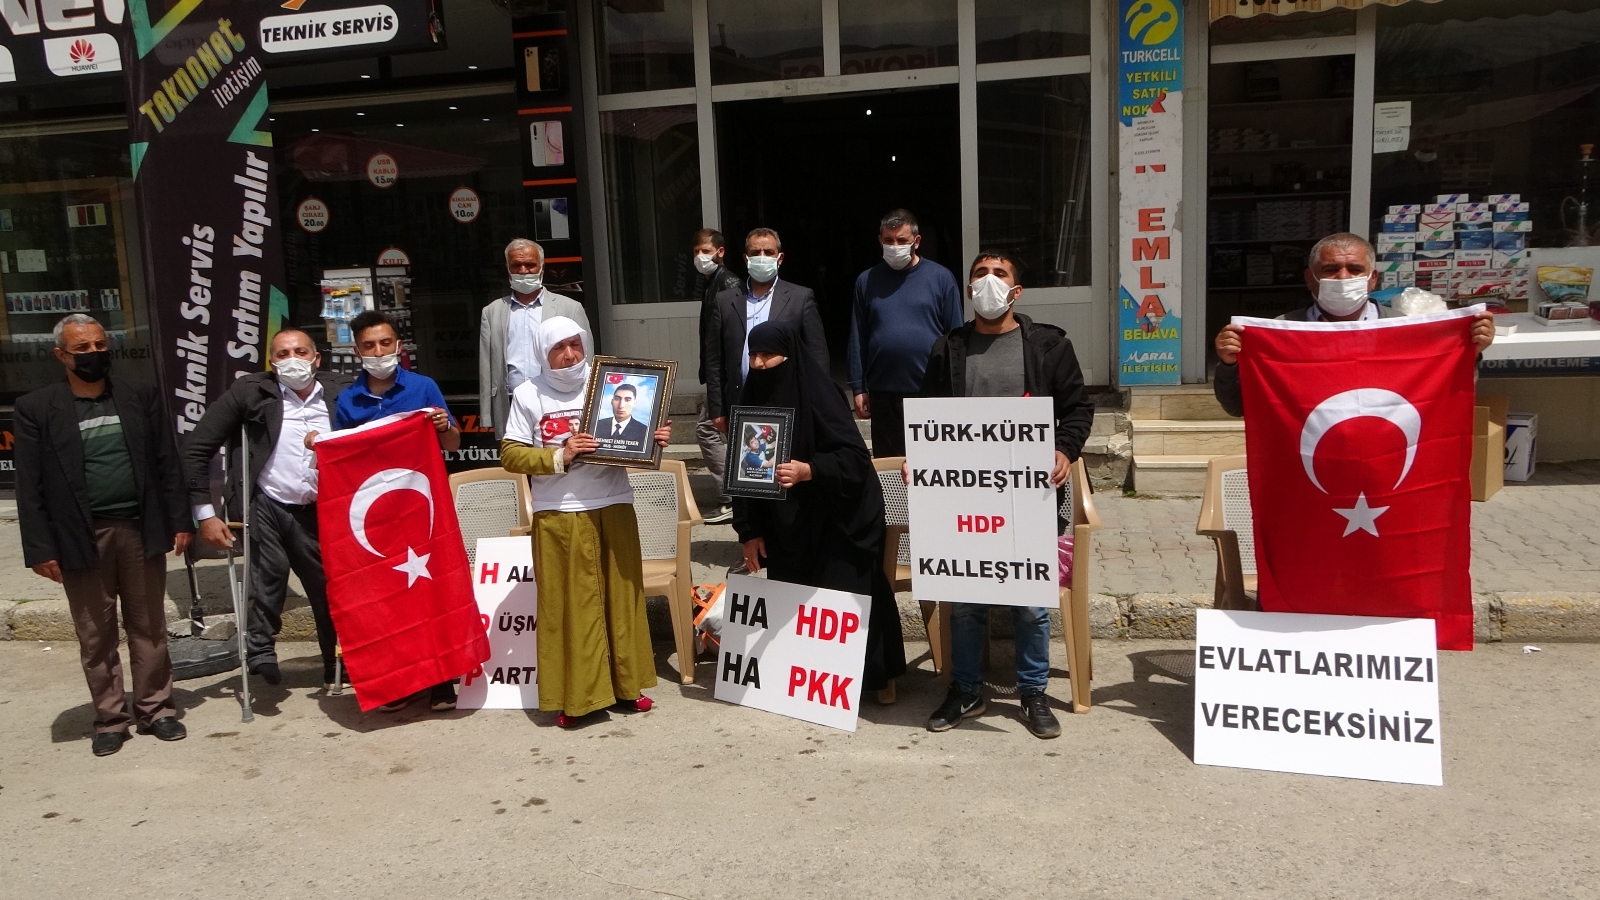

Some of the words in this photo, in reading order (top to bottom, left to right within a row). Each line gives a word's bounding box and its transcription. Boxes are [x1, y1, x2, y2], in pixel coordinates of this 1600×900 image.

[263, 20, 327, 43] TEKNİK
[332, 12, 393, 36] SERVİS
[71, 64, 98, 72] HUAWEI
[1122, 48, 1180, 63] TURKCELL
[211, 56, 262, 109] iletişim
[1126, 68, 1177, 83] YETKİLİ
[233, 150, 272, 259] Yapılır
[304, 219, 325, 227] 20.00
[180, 223, 215, 326] Servis
[226, 269, 262, 364] Satım
[1123, 328, 1179, 341] BEDAVA
[1122, 362, 1179, 374] İLETİŞİM
[909, 420, 1050, 443] TÜRK-KÜRT
[913, 466, 1051, 494] KARDEŞTİR
[957, 515, 1006, 534] HDP
[480, 563, 500, 585] H
[506, 566, 537, 583] AL
[919, 558, 1051, 584] KALLEŞTİR
[729, 593, 769, 630] HA
[795, 604, 860, 645] HDP
[490, 666, 539, 685] ART
[1198, 645, 1434, 683] EVLATLARIMIZI
[722, 651, 761, 690] HA
[787, 665, 854, 711] PKK
[1200, 702, 1435, 745] VERECEKSİNİZ
